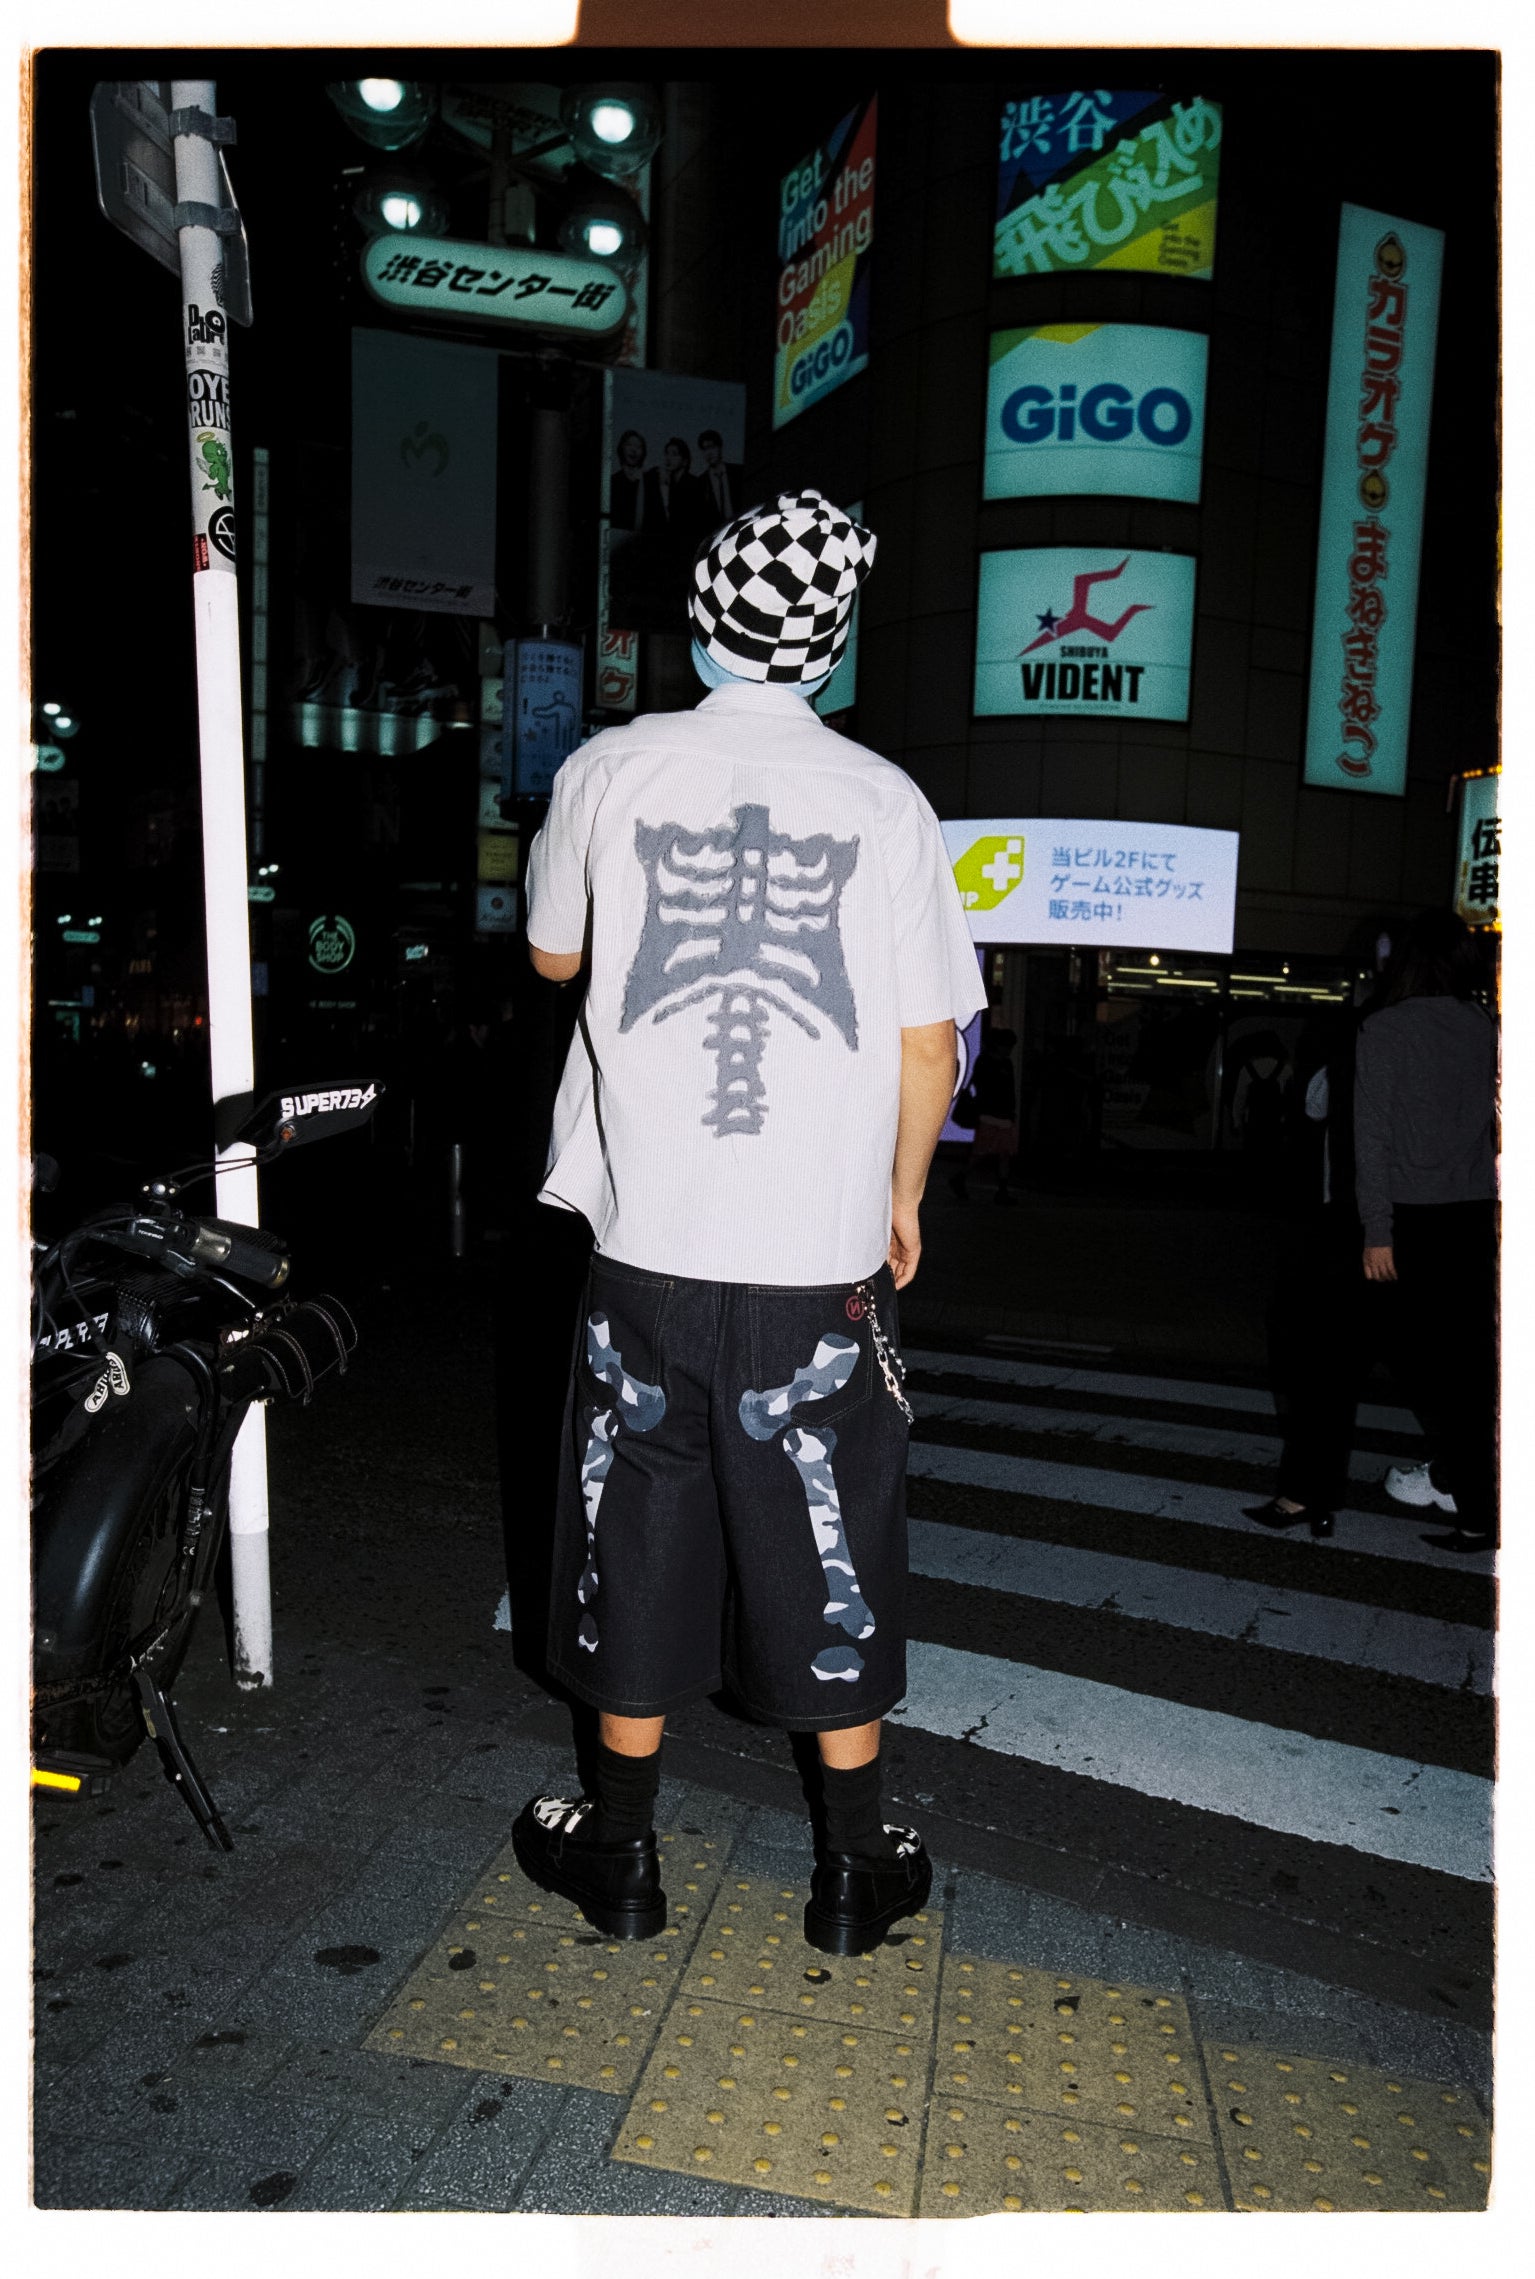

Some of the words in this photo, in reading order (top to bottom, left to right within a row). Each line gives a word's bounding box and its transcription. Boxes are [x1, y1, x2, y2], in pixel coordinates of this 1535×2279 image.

[1000, 89, 1118, 162] 渋谷
[783, 146, 824, 214] Get
[834, 157, 873, 215] the
[994, 96, 1222, 277] 飛び込め
[377, 253, 617, 312] 渋谷センター街
[780, 206, 873, 306] Gaming
[780, 281, 841, 349] Oasis
[791, 327, 850, 395] GiGO
[1358, 275, 1407, 470] カラオケ
[1001, 383, 1193, 447] GiGO
[1061, 646, 1108, 658] SHIBUYA
[1336, 516, 1391, 778] まねきねこ
[1022, 663, 1144, 702] VIDENT
[1050, 872, 1205, 901] ゲーム公式グッズ
[1052, 846, 1177, 873] 当ビル2Fにて
[281, 1088, 364, 1119] SUPER73
